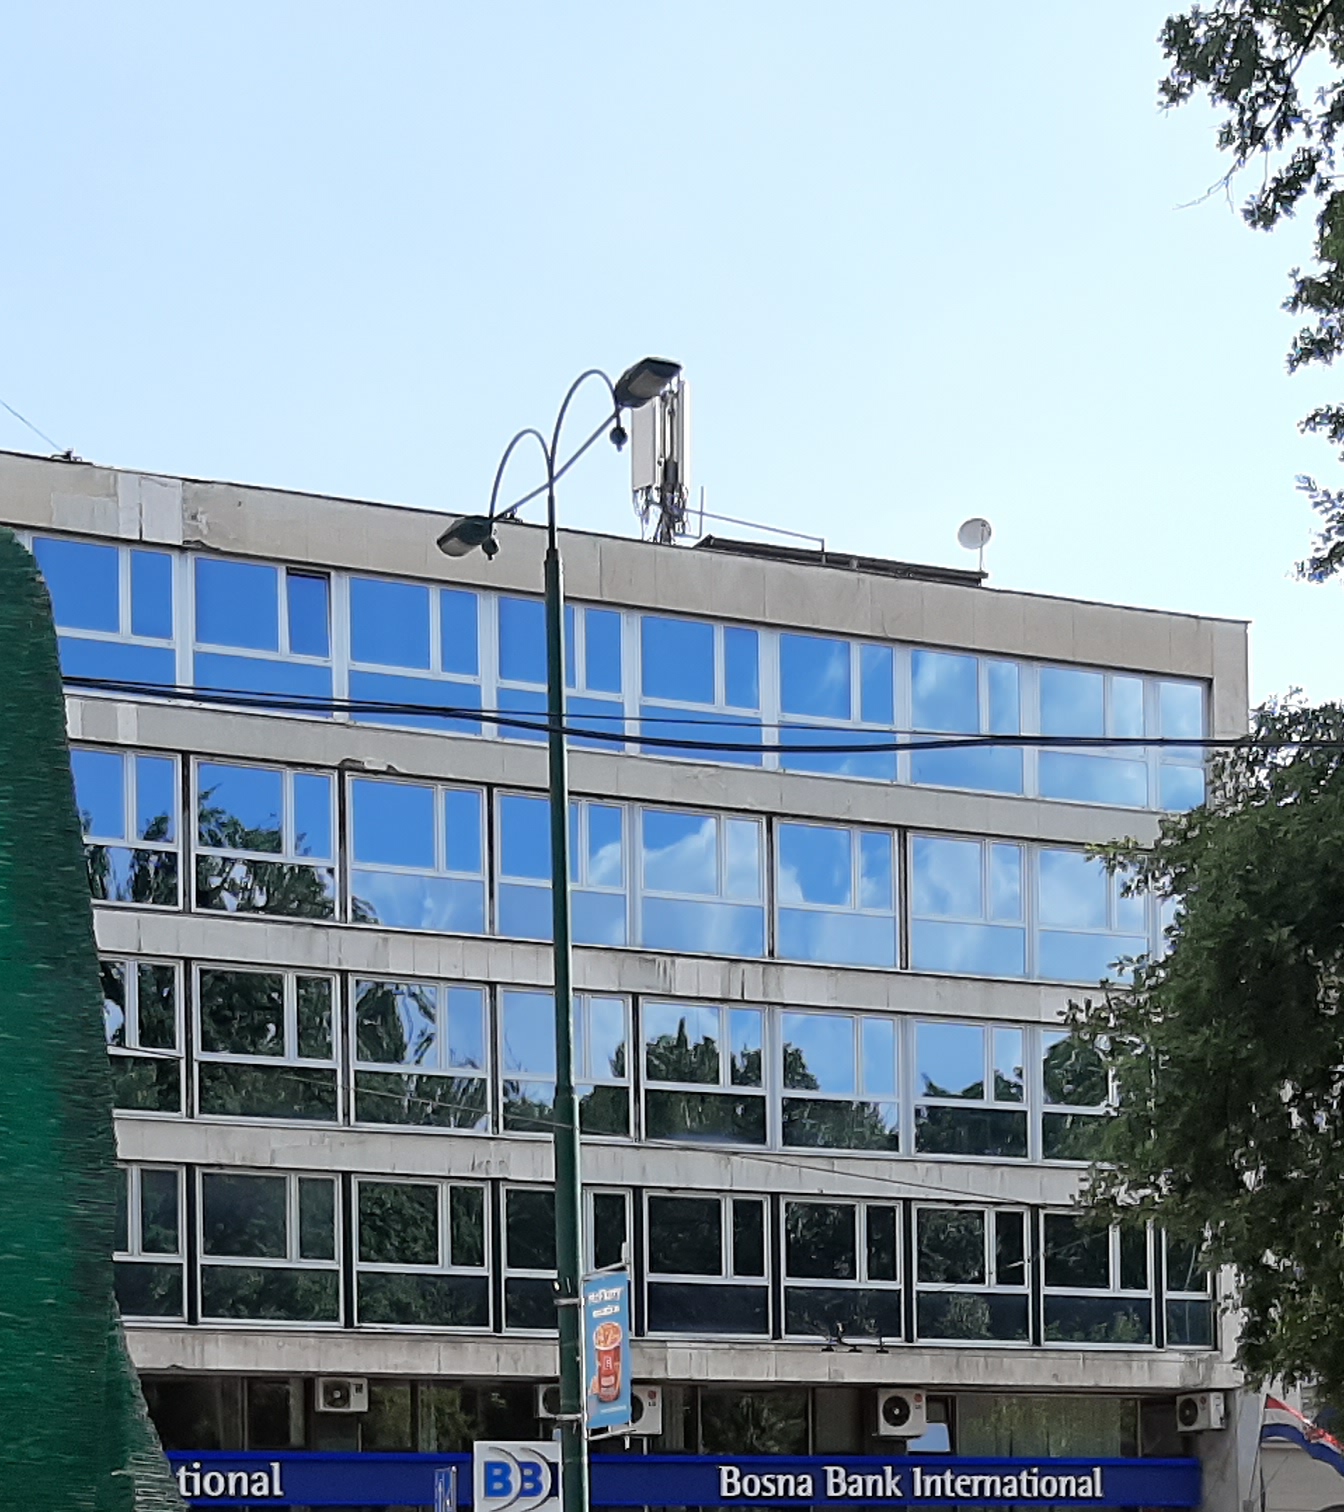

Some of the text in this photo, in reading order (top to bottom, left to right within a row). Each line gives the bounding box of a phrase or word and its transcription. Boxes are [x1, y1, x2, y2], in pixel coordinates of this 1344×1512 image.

[717, 1465, 1104, 1498] Bosna Bank International
